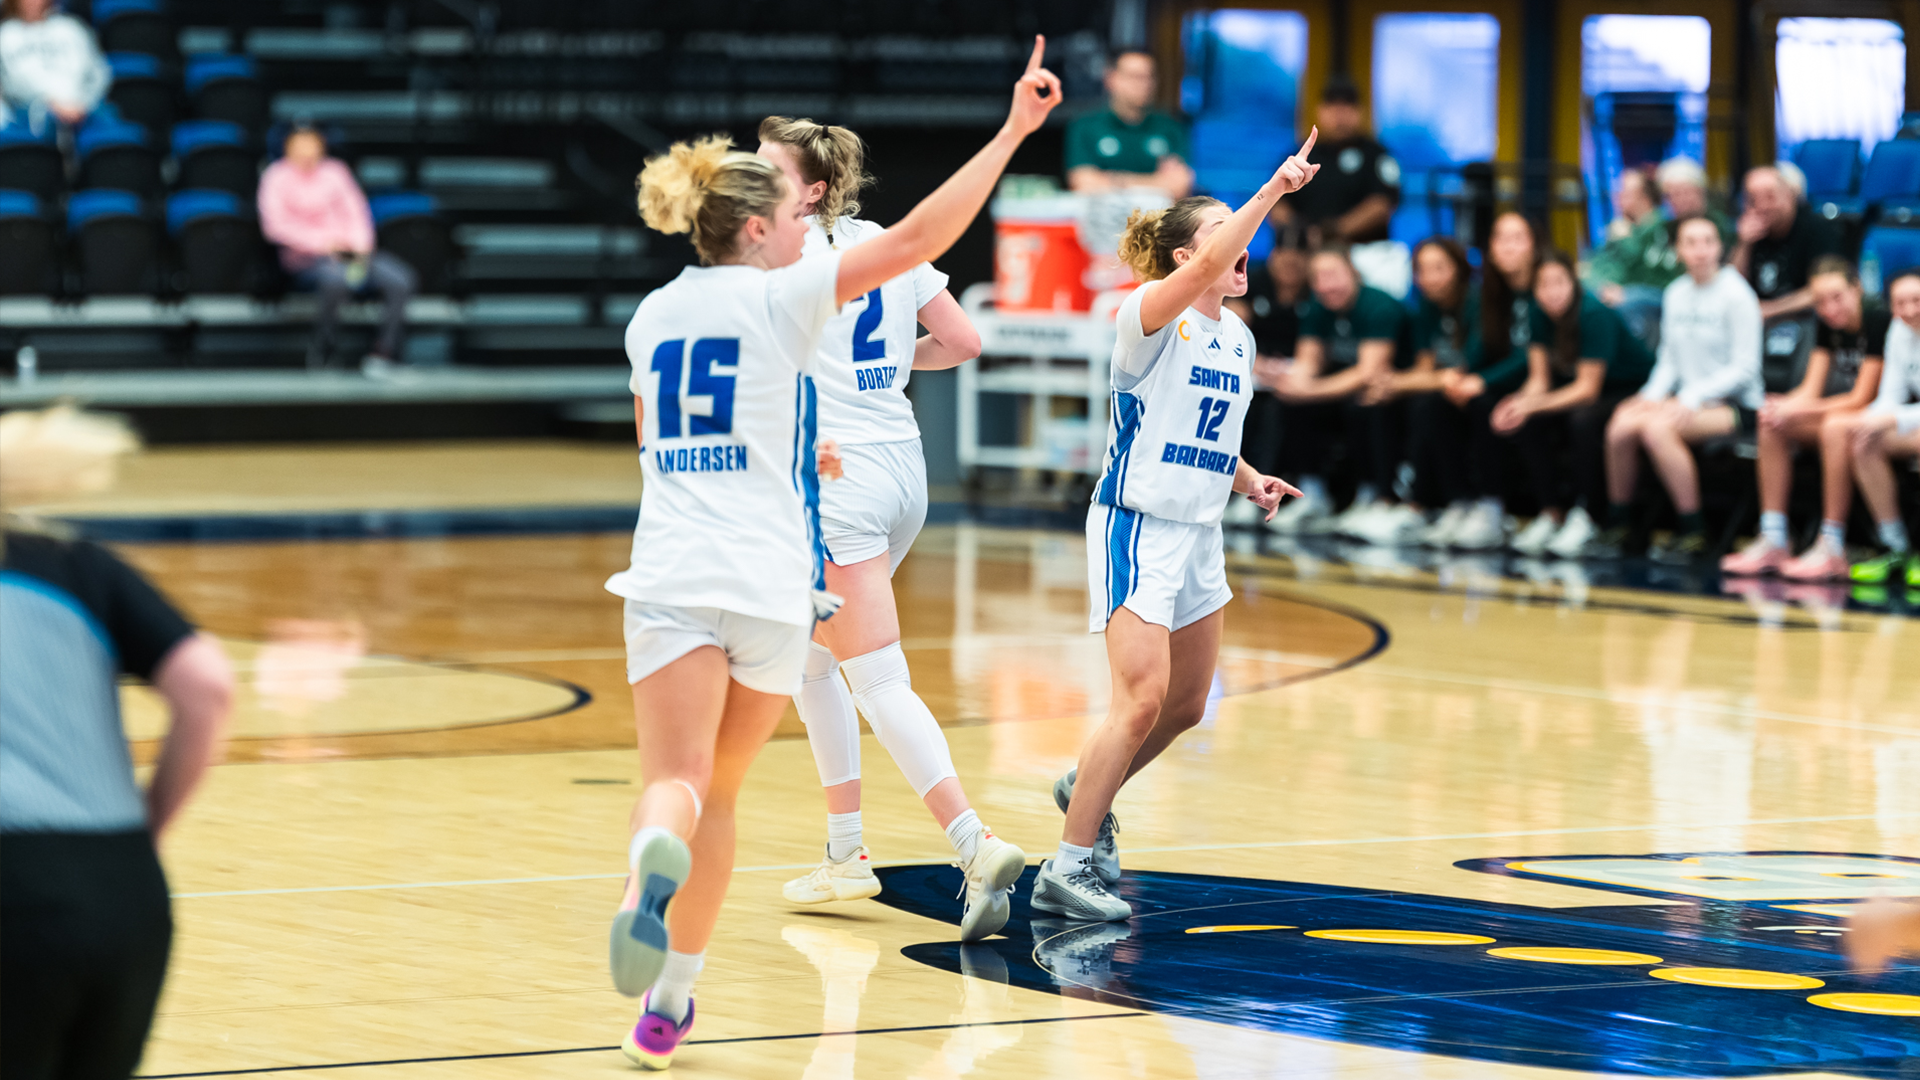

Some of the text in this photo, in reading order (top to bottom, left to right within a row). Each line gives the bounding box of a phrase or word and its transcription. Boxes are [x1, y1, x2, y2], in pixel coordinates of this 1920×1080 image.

[850, 286, 886, 363] 2
[650, 337, 740, 438] 15
[1188, 365, 1240, 395] SANTA
[1195, 396, 1231, 443] 12
[655, 445, 747, 474] ANDERSEN
[1160, 441, 1238, 476] BARBARA
